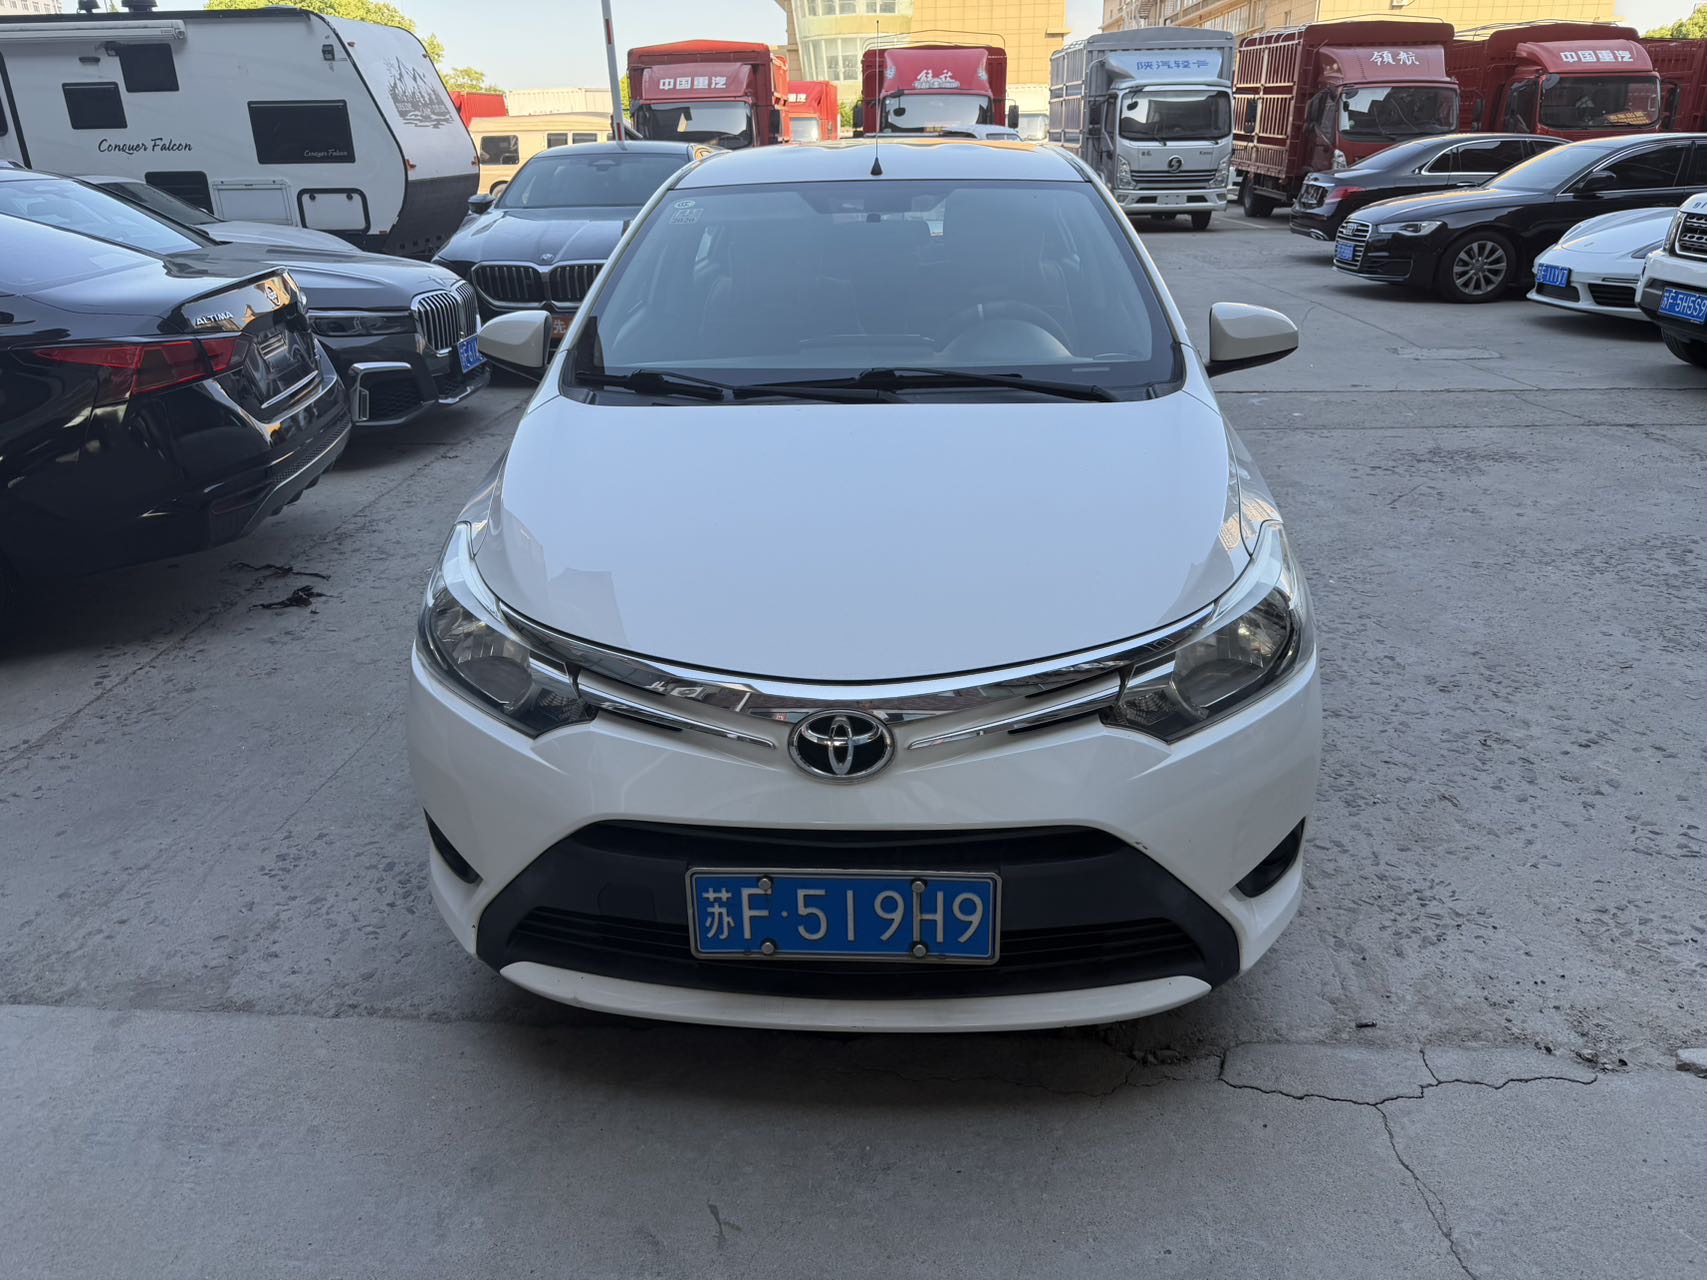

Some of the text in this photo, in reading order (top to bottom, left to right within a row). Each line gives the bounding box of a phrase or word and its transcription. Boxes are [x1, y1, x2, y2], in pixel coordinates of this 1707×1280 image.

[1560, 50, 1634, 63] 中国重汽
[1136, 60, 1209, 70] 陕汽轻卡
[659, 76, 727, 90] 中国重汽
[98, 137, 193, 155] Conquer Falcon
[195, 311, 234, 326] ALTIMA
[702, 887, 984, 944] 苏F·519H9
